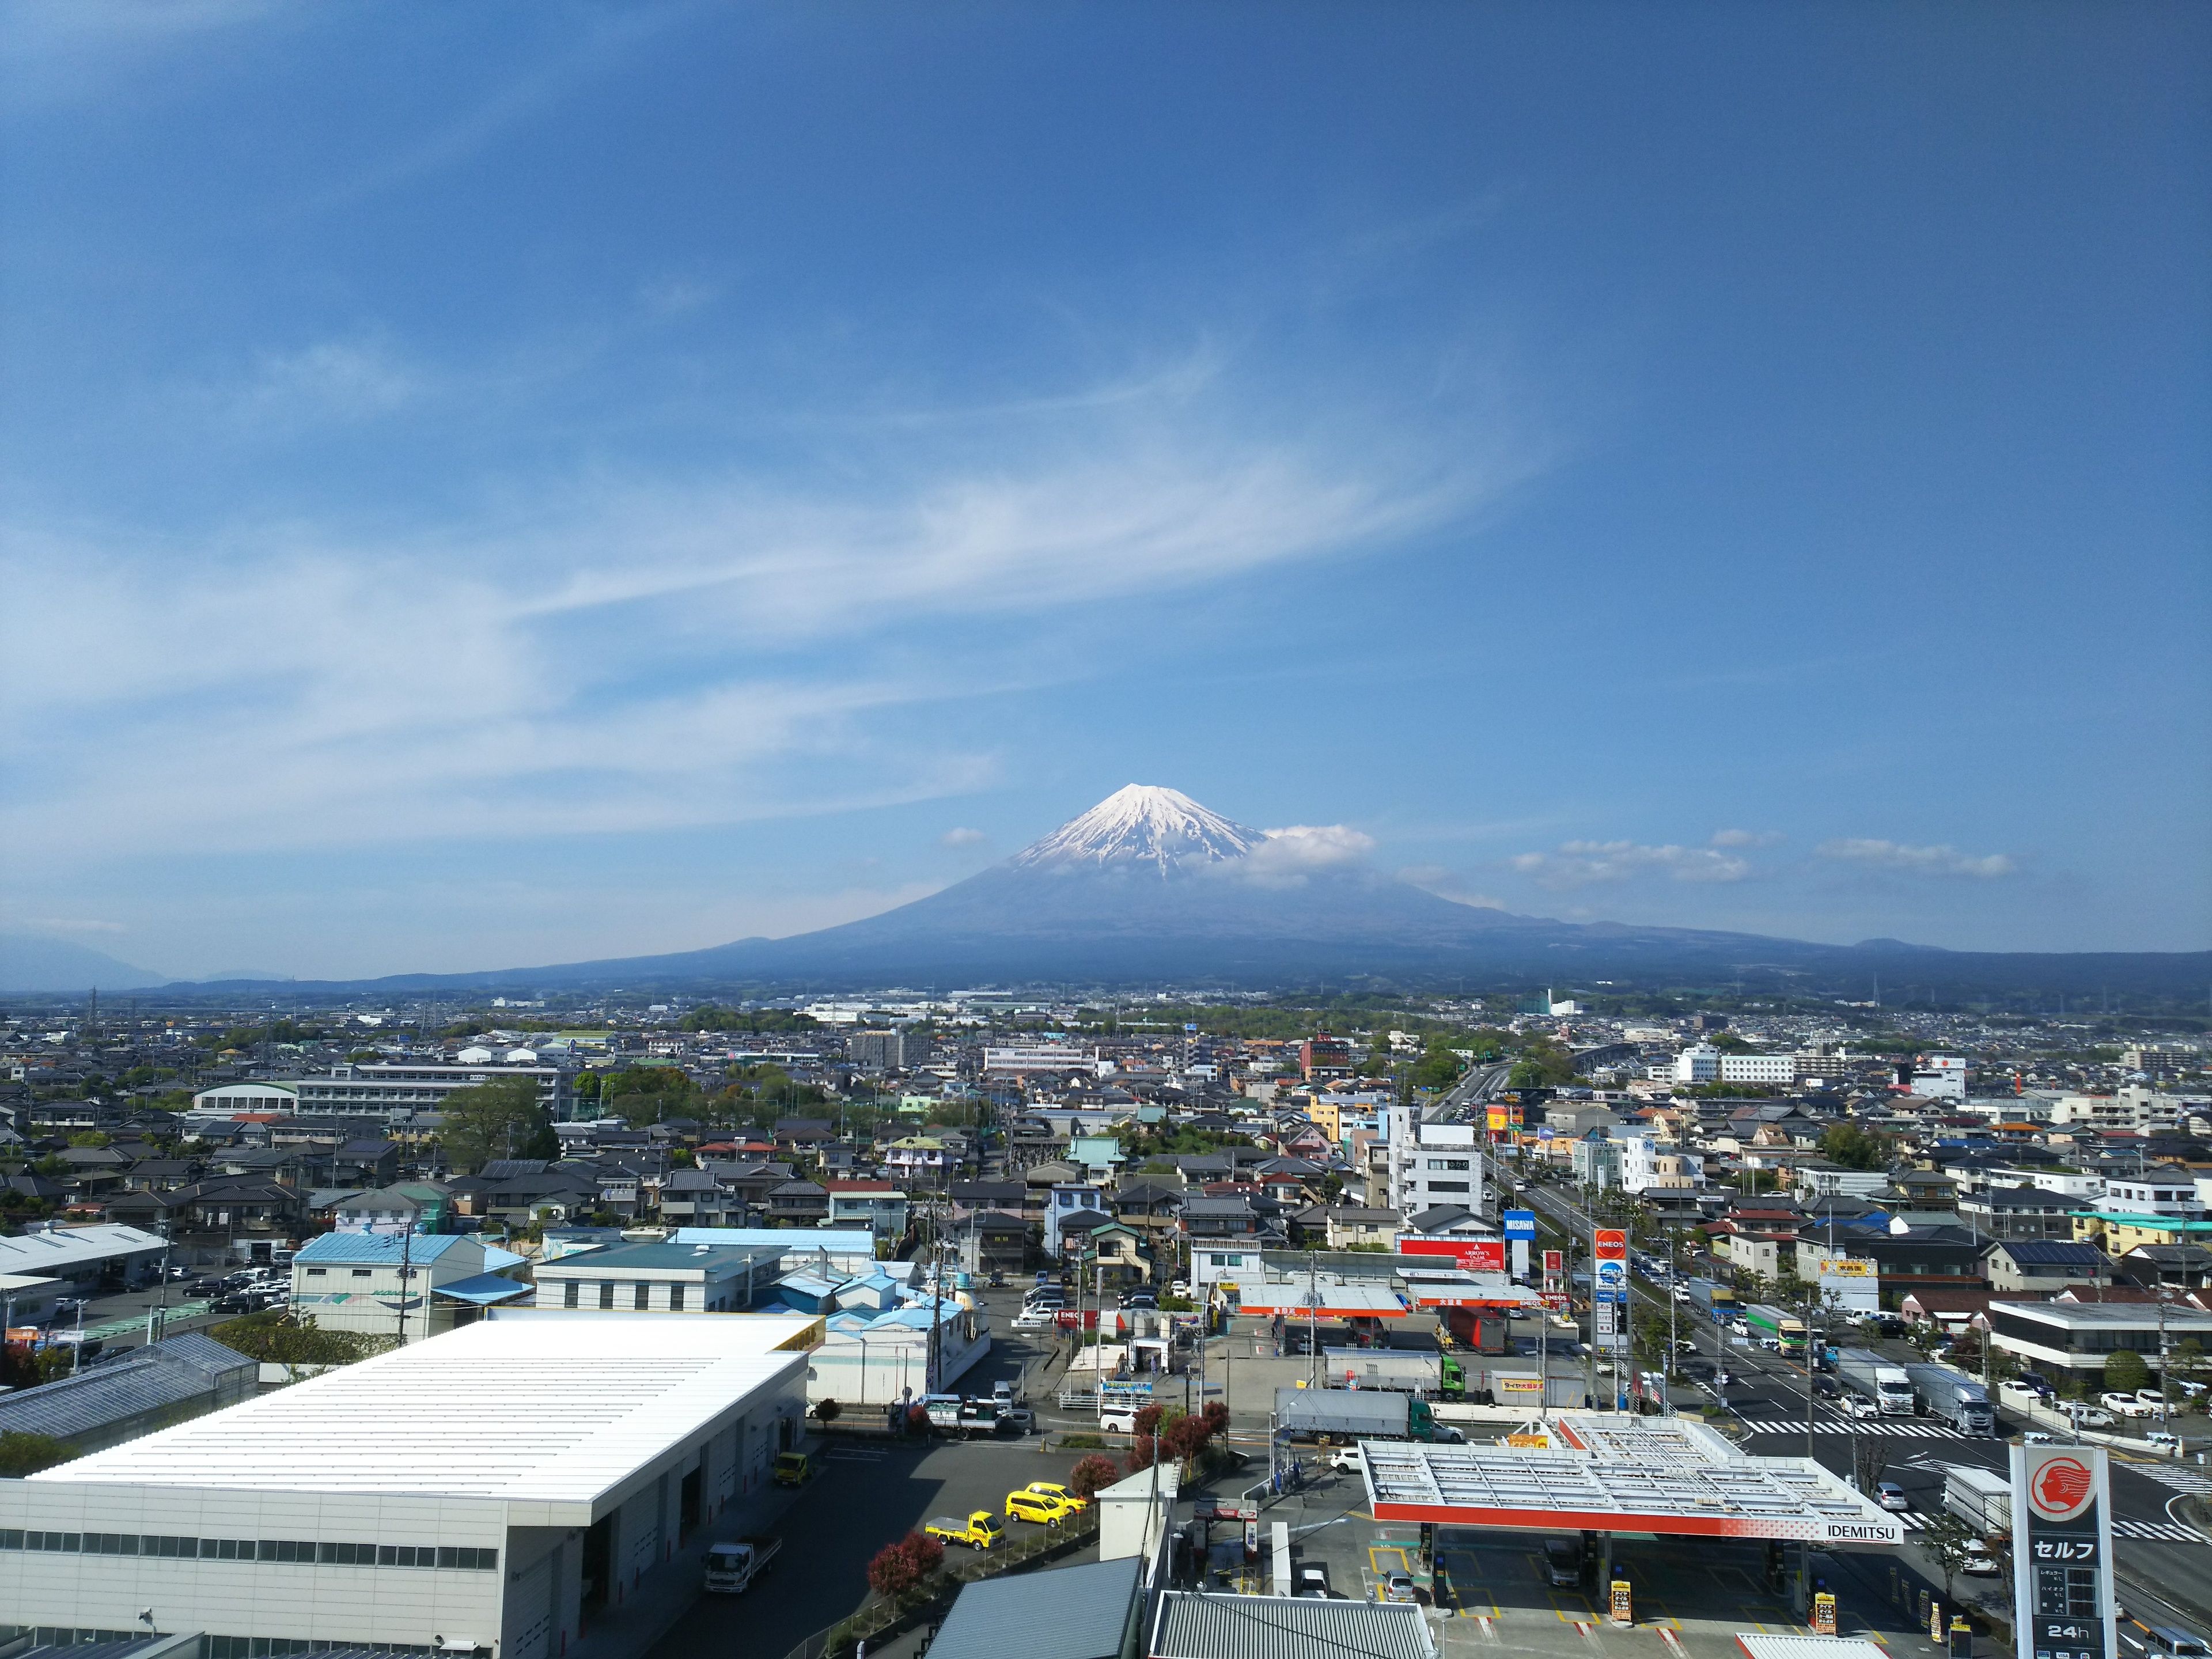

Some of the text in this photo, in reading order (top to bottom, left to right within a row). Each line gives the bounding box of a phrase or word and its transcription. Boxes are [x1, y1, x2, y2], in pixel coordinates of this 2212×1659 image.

[1506, 1219, 1535, 1230] MISAWA
[1828, 1525, 1895, 1540] IDEMITSU
[2035, 1540, 2094, 1559] セルフ
[2048, 1625, 2089, 1639] 24h
